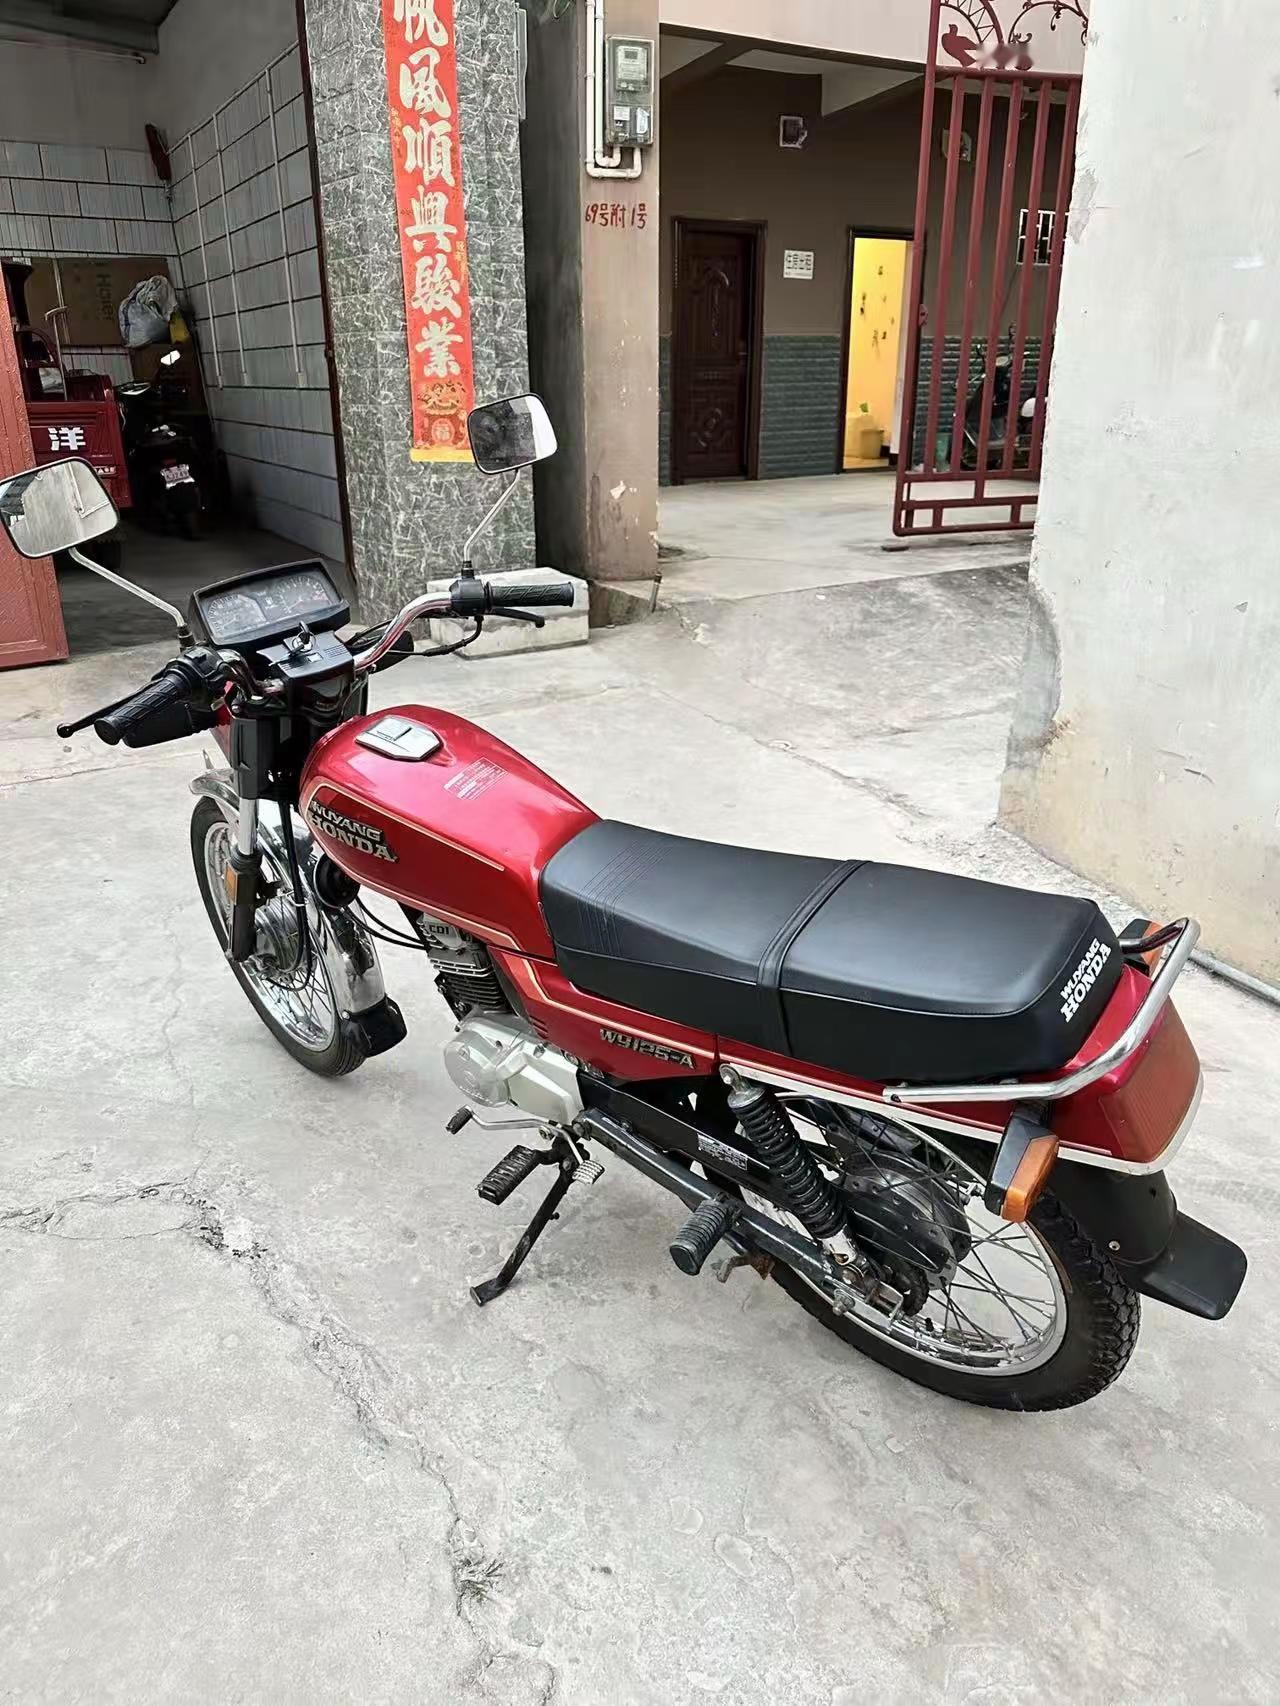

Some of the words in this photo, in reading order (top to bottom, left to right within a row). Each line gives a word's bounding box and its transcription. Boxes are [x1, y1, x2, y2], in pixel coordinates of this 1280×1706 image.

[48, 427, 86, 450] 洋
[308, 814, 397, 863] HONDA
[310, 801, 383, 842] WUYANG
[429, 925, 450, 935] CDI
[1060, 938, 1101, 1000] WUYANG
[1060, 943, 1111, 1023] HONDA
